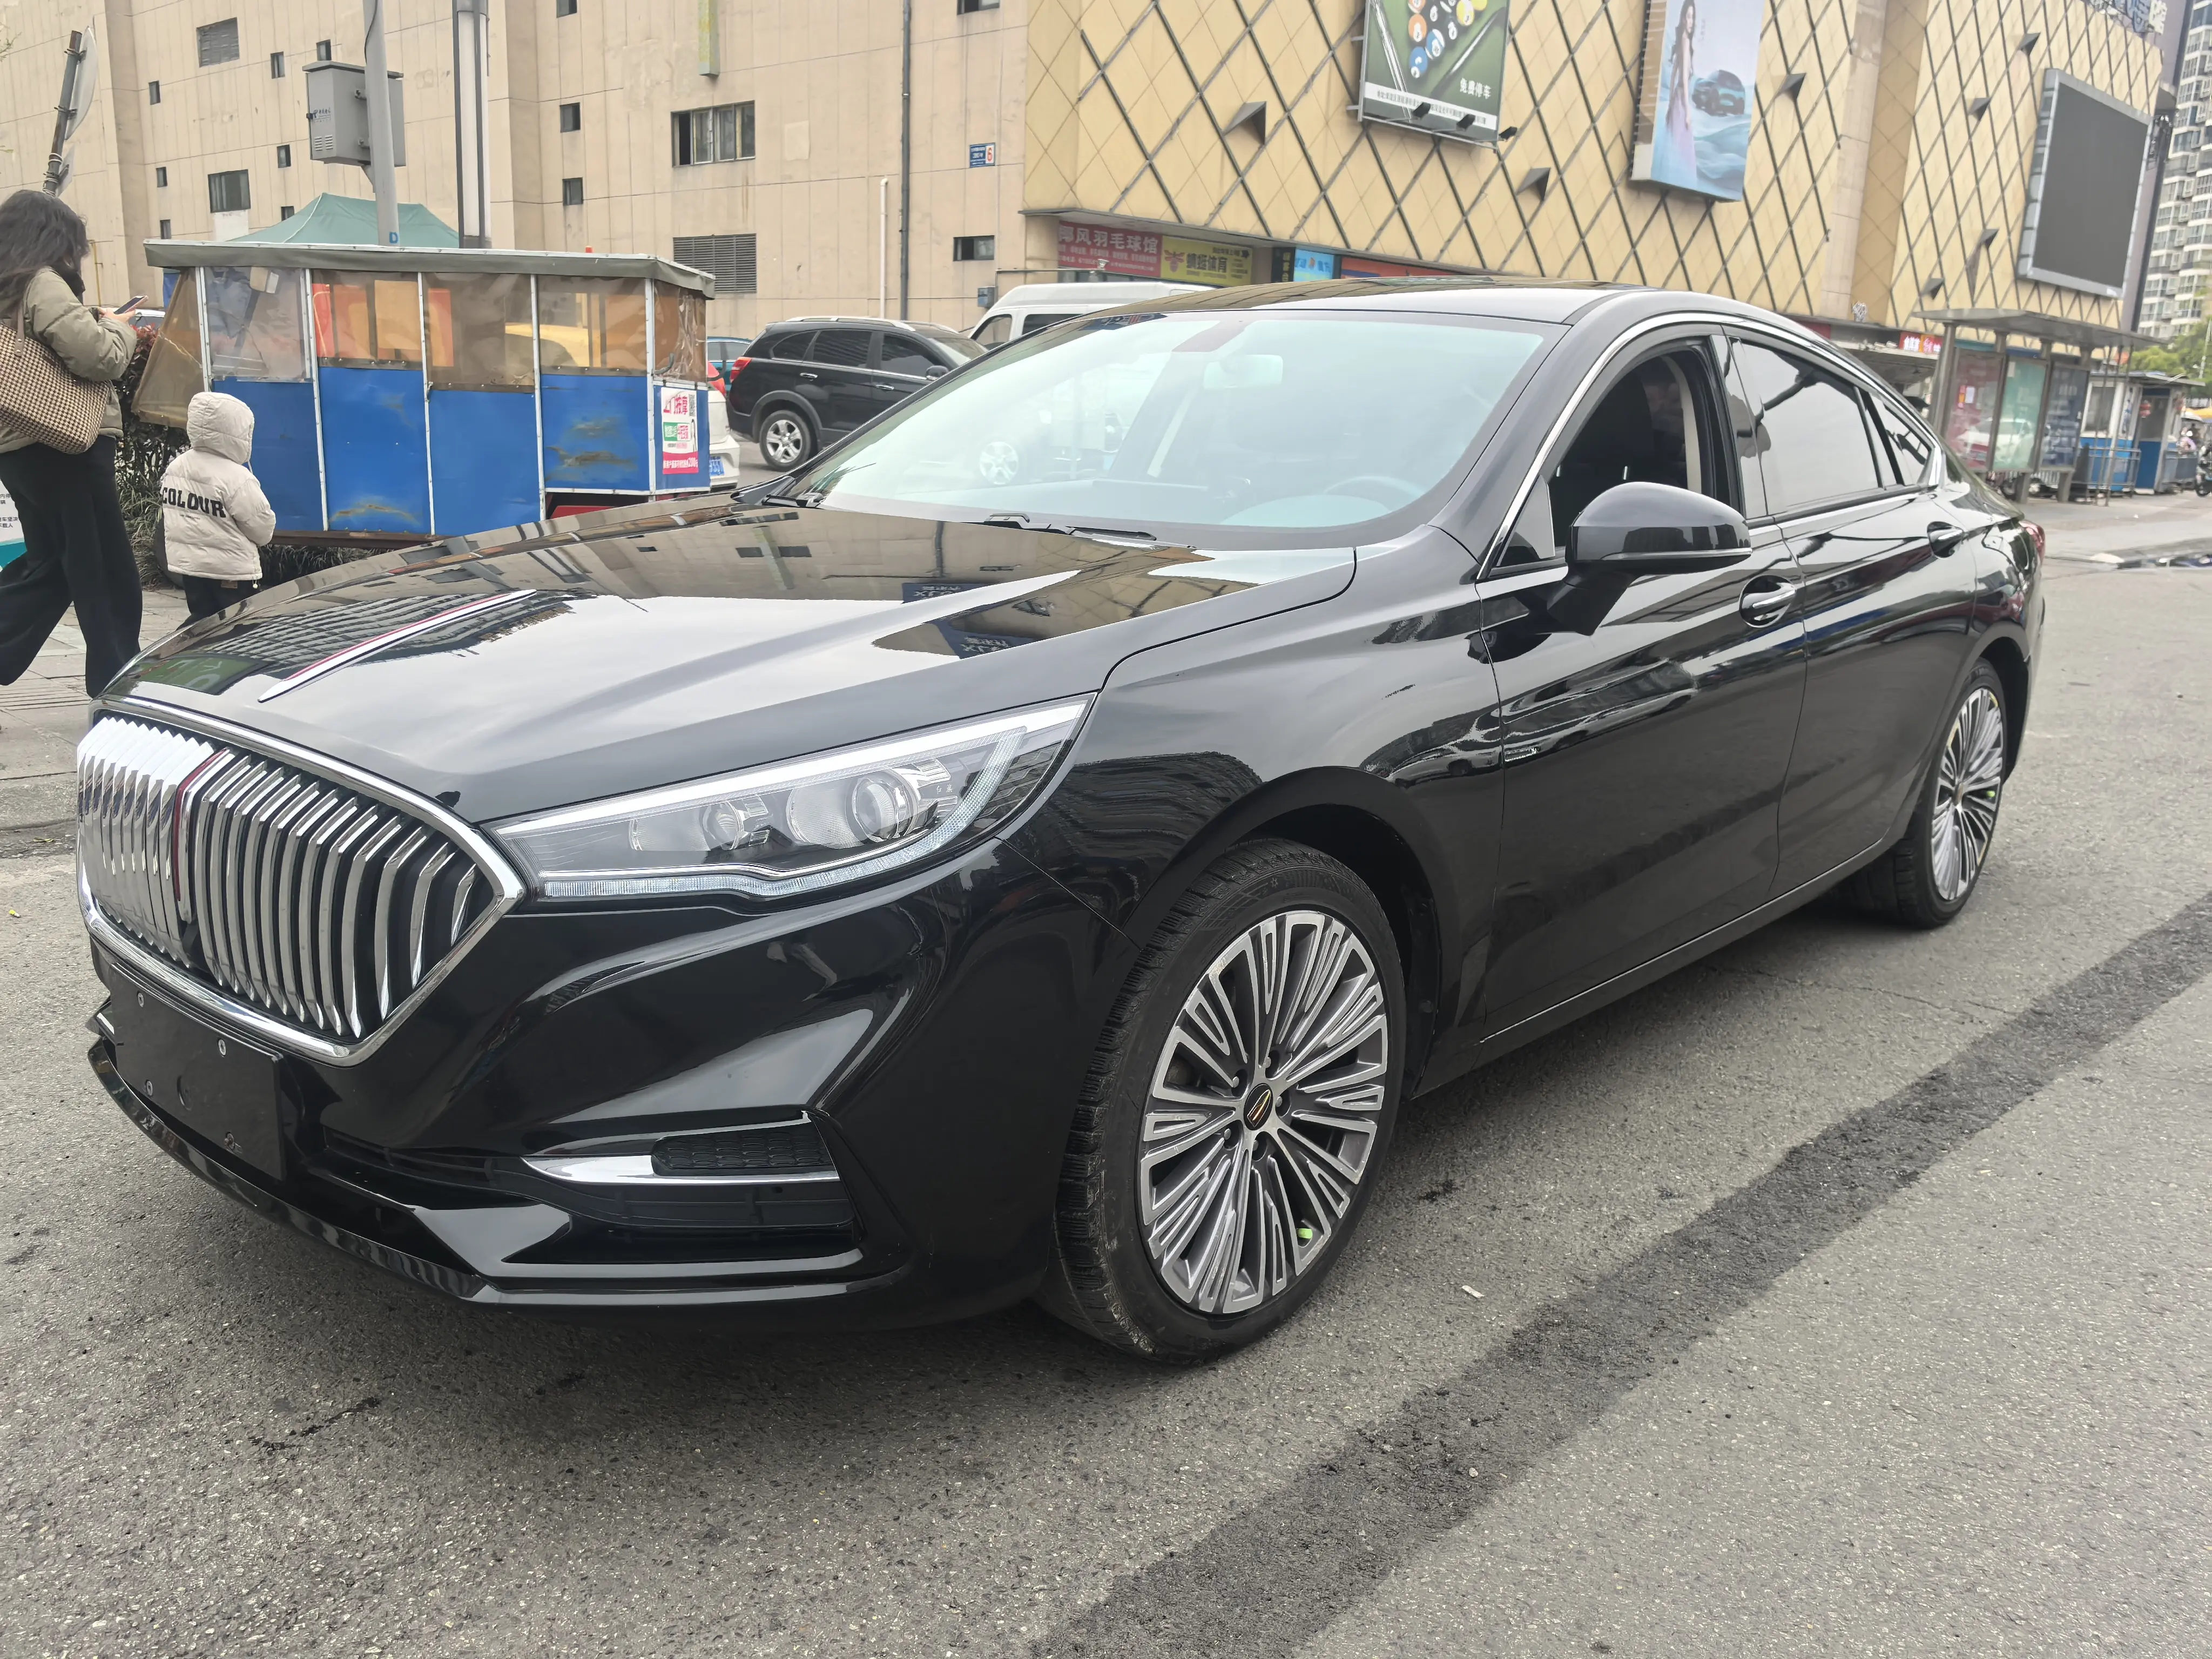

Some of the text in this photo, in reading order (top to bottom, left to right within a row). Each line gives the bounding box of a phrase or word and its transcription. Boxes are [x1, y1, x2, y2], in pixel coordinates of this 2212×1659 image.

[1460, 78, 1492, 99] 免费停车
[163, 487, 226, 518] COLOUR
